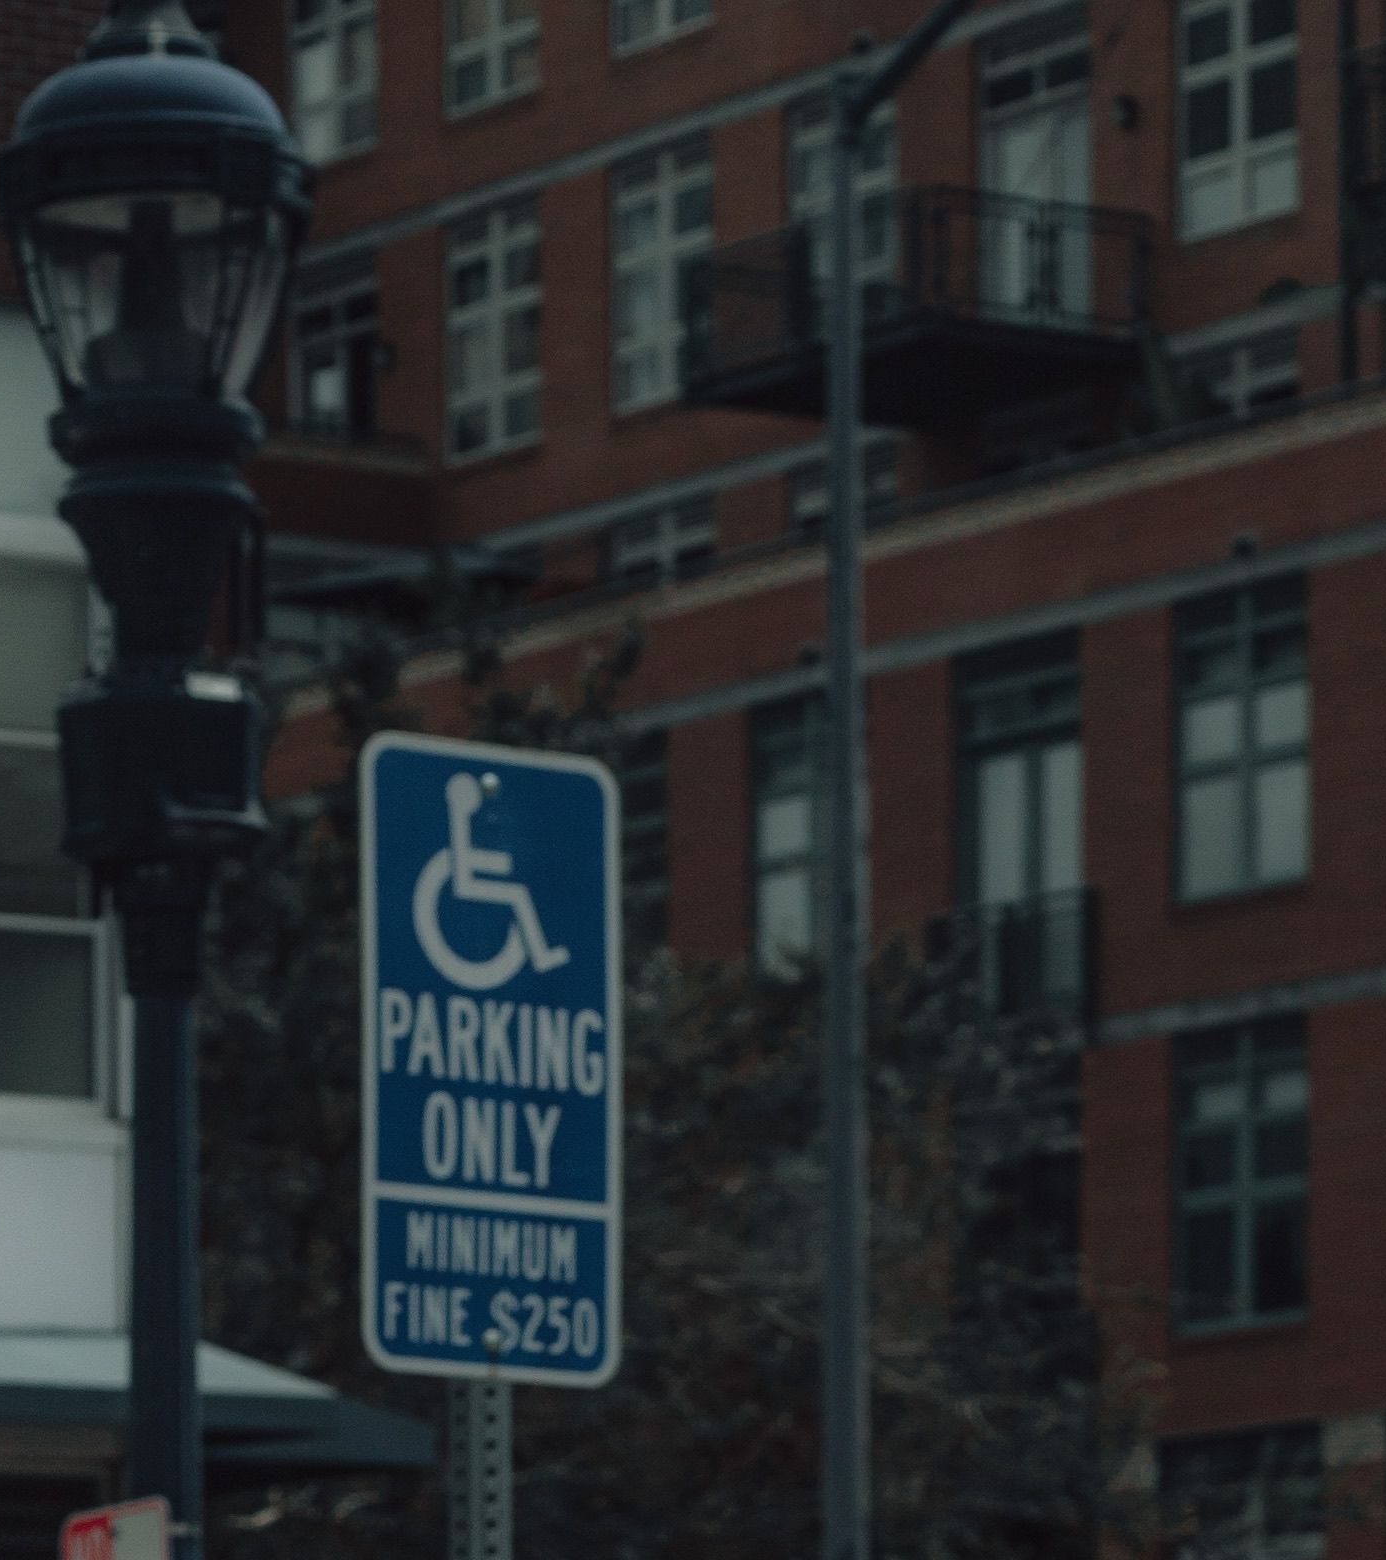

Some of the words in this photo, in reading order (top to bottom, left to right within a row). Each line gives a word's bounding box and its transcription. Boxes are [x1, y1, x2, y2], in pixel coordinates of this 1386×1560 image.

[379, 988, 604, 1096] PARKING
[421, 1091, 561, 1188] ONLY
[406, 1211, 577, 1283] MINIMUM
[383, 1281, 472, 1347] FINE
[489, 1292, 599, 1358] $250
